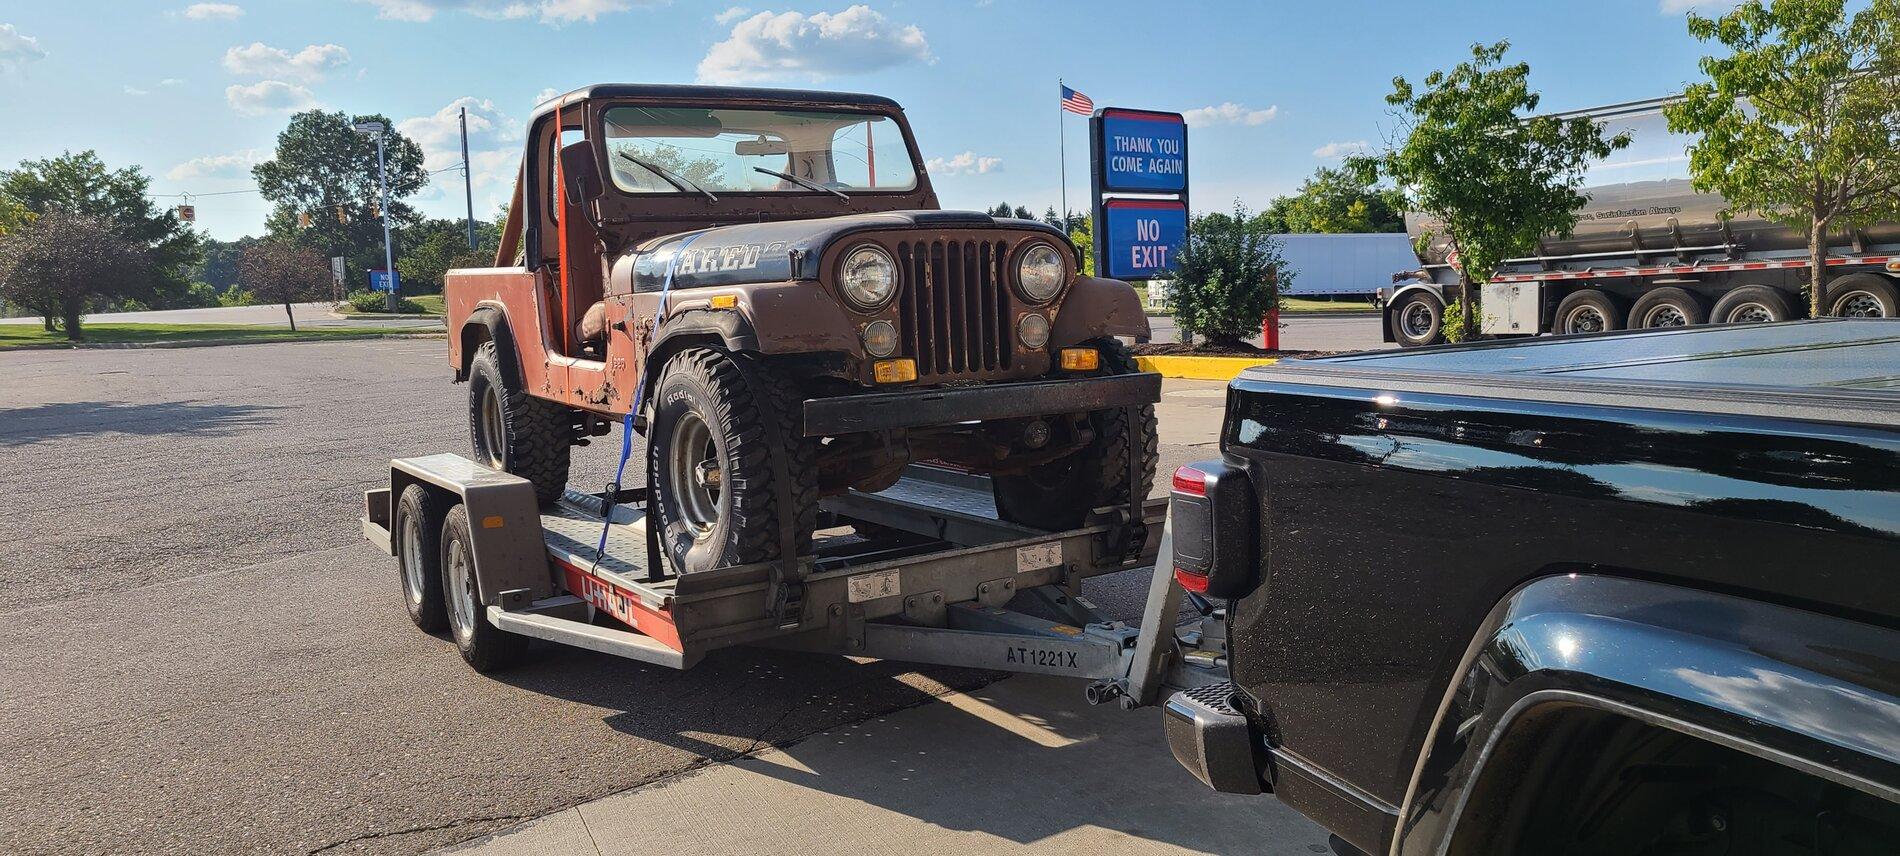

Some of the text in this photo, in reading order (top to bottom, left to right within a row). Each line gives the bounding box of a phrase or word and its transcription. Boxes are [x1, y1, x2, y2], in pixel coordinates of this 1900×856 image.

[1114, 136, 1179, 154] THANK YOU
[1112, 156, 1183, 174] COME AGAIN
[1596, 208, 1647, 220] Satisfaction
[1648, 206, 1681, 215] Always
[1137, 219, 1160, 242] NO
[1132, 245, 1168, 269] EXIT
[380, 273, 389, 281] NO
[667, 390, 696, 406] Radial
[1007, 646, 1078, 669] AT1221X
